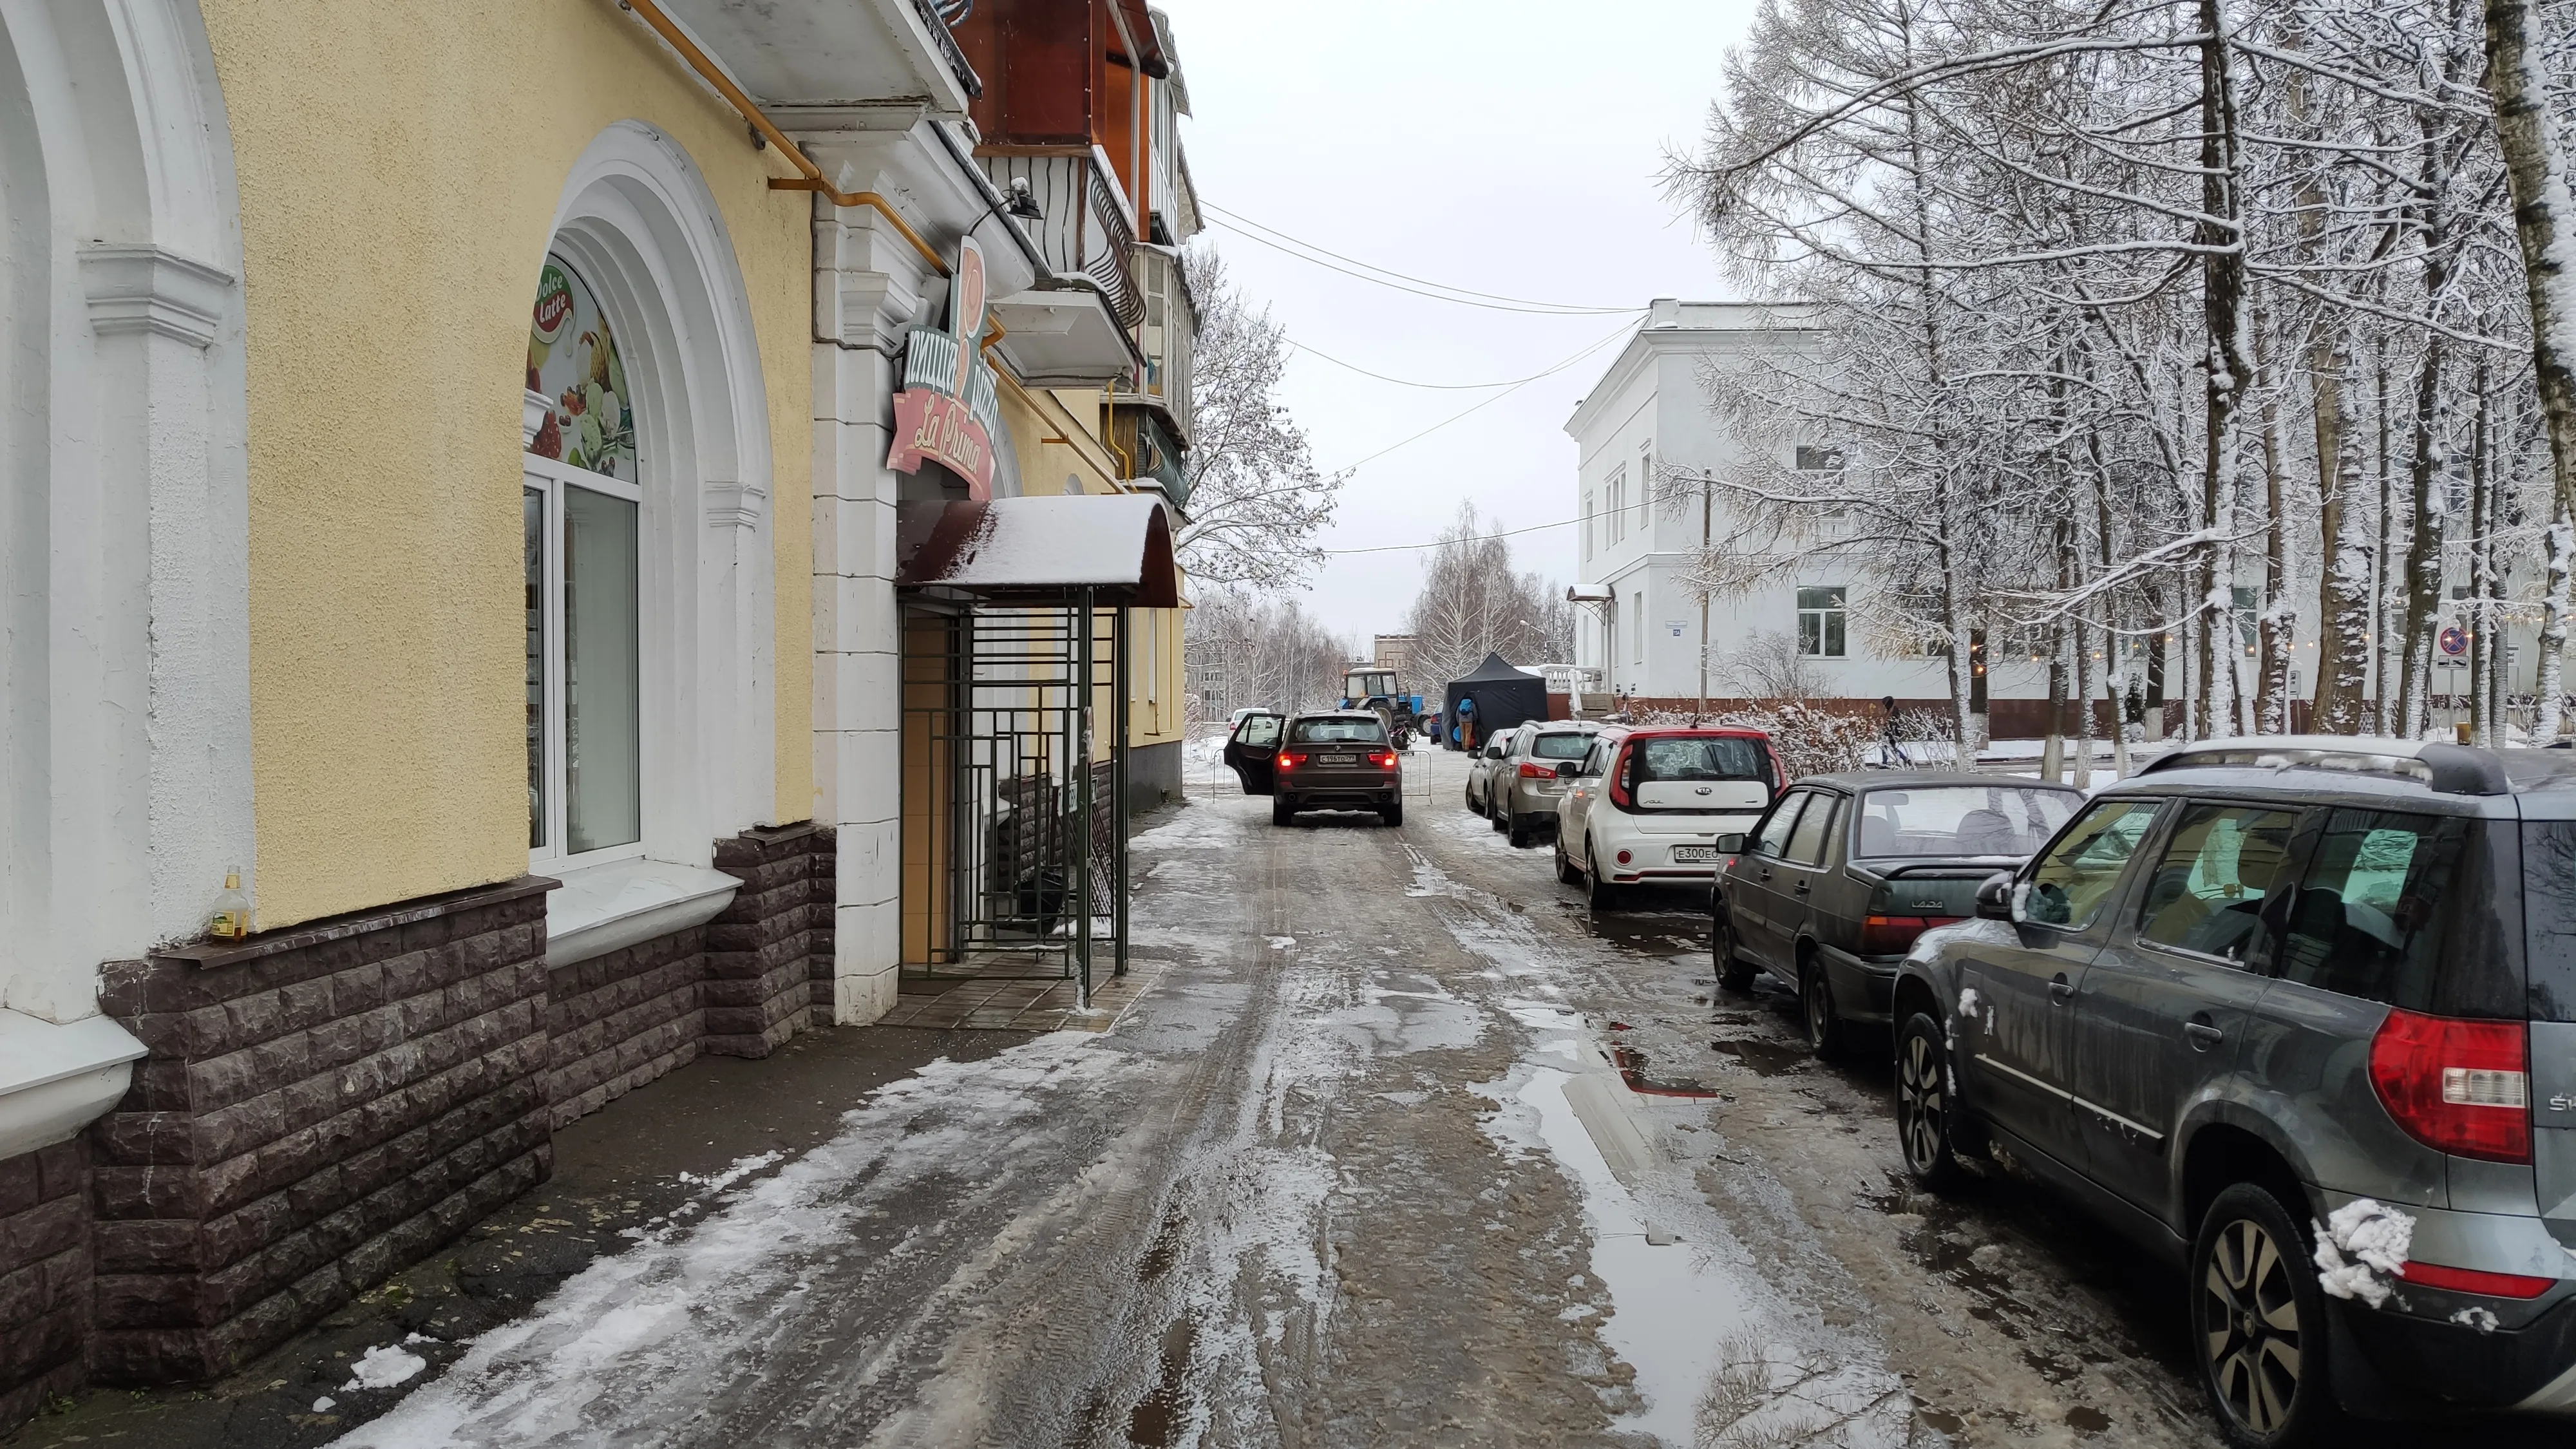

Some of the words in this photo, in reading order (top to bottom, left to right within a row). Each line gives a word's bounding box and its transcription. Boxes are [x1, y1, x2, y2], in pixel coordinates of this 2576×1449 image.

[540, 294, 566, 323] Latte
[914, 394, 940, 448] La
[938, 403, 981, 475] Prima
